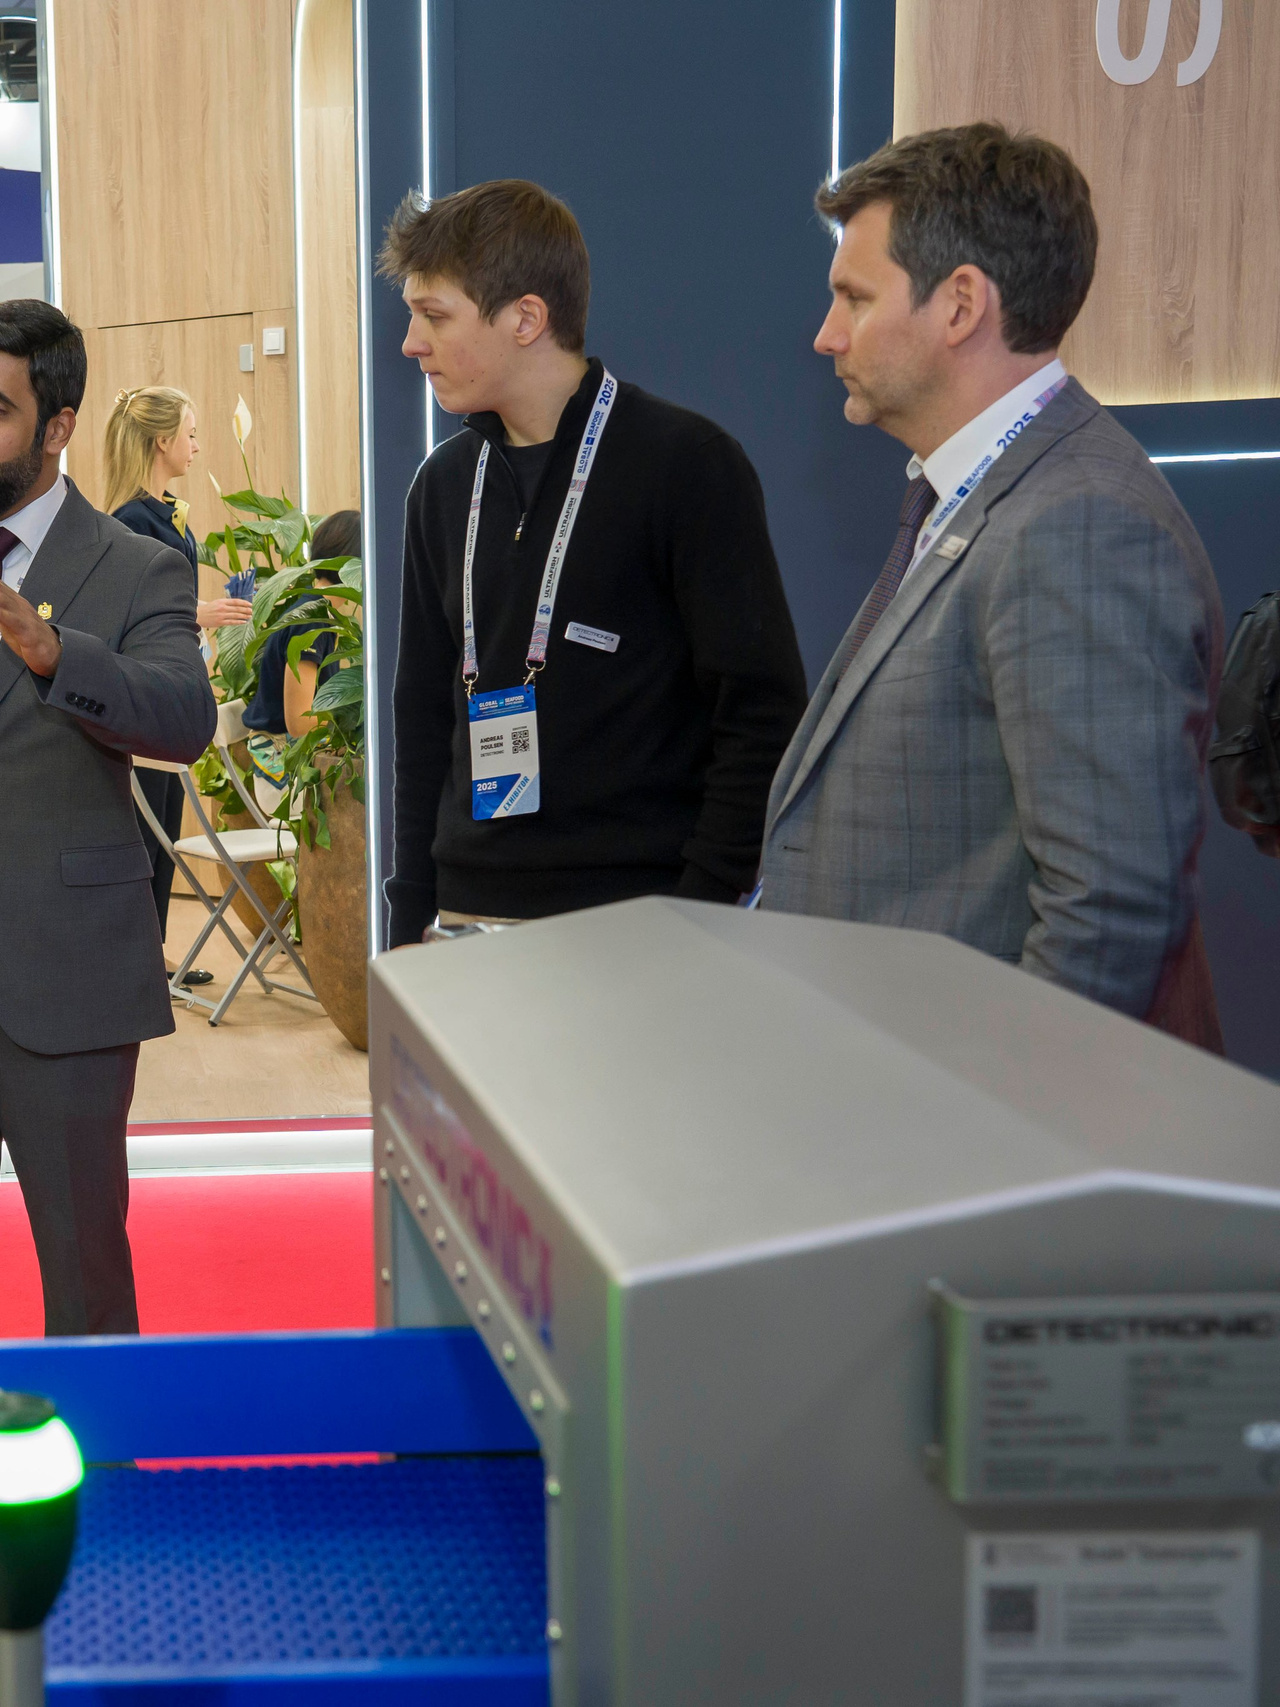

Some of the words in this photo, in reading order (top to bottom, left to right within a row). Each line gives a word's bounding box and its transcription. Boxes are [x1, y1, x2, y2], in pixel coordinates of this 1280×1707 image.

[577, 446, 589, 474] GLOBAL
[588, 410, 600, 436] SEAFOOD
[598, 378, 615, 406] 2025
[964, 455, 992, 487] SEAFOOD
[996, 412, 1035, 450] 2025
[544, 556, 558, 598] ULTRAFISH
[558, 497, 574, 538] ULTRAFISH
[504, 694, 524, 703] SEAFOOD
[480, 734, 504, 744] ANDREAS
[480, 742, 504, 750] POULSEN
[476, 781, 498, 792] 2025
[502, 776, 530, 812] EXHIBITOR
